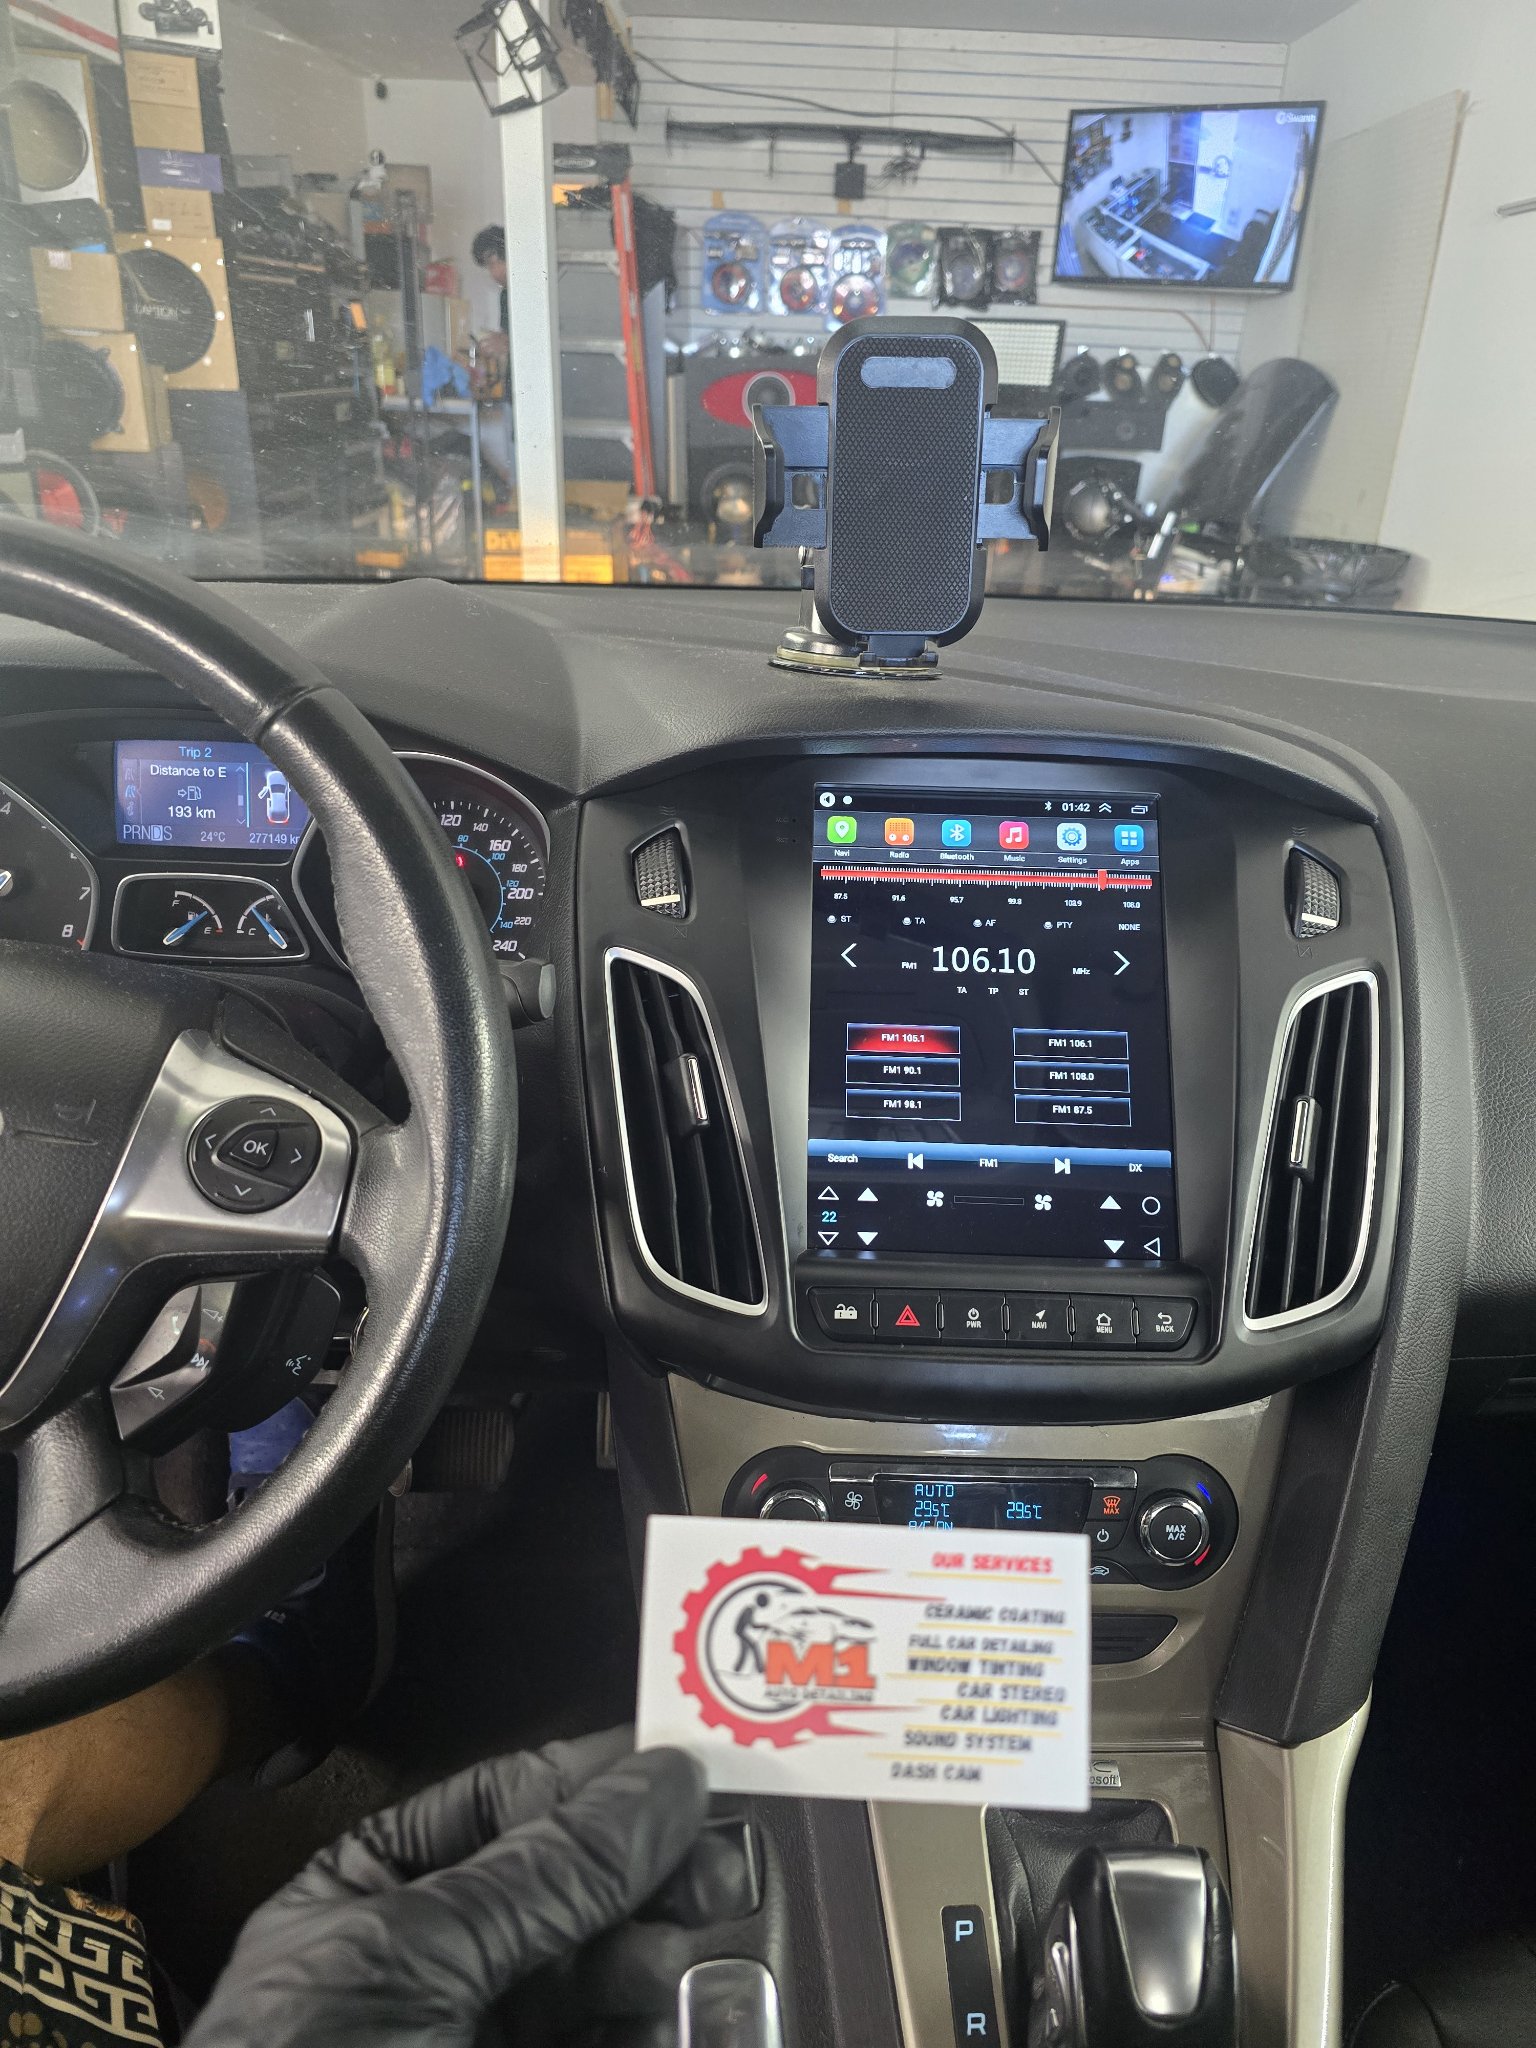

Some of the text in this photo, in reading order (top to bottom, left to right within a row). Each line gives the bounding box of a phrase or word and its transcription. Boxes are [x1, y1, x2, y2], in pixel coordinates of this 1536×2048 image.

[179, 747, 212, 758] Trip 2
[150, 765, 227, 778] Distance to E
[0, 802, 11, 815] 4
[1062, 801, 1091, 813] 01:42
[168, 806, 216, 819] 193 km
[440, 814, 462, 826] 120
[473, 823, 489, 832] 140
[200, 831, 226, 843] 24°C
[249, 833, 288, 844] 277149
[489, 840, 511, 851] 160
[492, 853, 505, 861] 100
[833, 849, 850, 858] Navi
[889, 850, 910, 859] Radio
[940, 852, 975, 862] Bluetooth
[1003, 854, 1026, 863] Music
[1057, 856, 1088, 866] Settings
[1120, 857, 1140, 867] Apps
[512, 864, 528, 873] 180
[506, 880, 519, 888] 120
[79, 886, 91, 900] 7
[507, 888, 534, 900] 200
[833, 892, 848, 901] 87.5
[950, 895, 965, 904] 95.7
[514, 917, 532, 926] 220
[840, 915, 852, 924] ST
[914, 917, 926, 926] TA
[985, 919, 997, 927] AF
[500, 921, 513, 929] 140
[1056, 920, 1074, 930] PTY
[1118, 922, 1141, 932] NONE
[62, 924, 74, 938] 8
[204, 927, 212, 935] E
[248, 928, 257, 936] C
[492, 939, 518, 952] 240
[901, 945, 1091, 976] FM1 106.10 MHz
[956, 986, 1030, 996] TA TP ST
[881, 1033, 925, 1043] FM1 105.1
[1048, 1038, 1092, 1048] FM1 106.1
[883, 1065, 922, 1075] FM1 90.1
[1049, 1071, 1095, 1081] FM1 108.0
[883, 1099, 922, 1109] FM1 98.1
[1052, 1105, 1093, 1115] FM1 87.5
[243, 1140, 270, 1156] OK
[827, 1153, 858, 1163] Search
[979, 1158, 998, 1168] FM1
[1128, 1163, 1143, 1172] DX
[821, 1211, 838, 1223] 22
[966, 1320, 982, 1329] PWR
[1031, 1321, 1048, 1330] NAVI
[1096, 1325, 1113, 1334] MENU
[1155, 1324, 1175, 1333] BACK
[914, 1484, 955, 1498] AUTO
[1102, 1506, 1121, 1515] MAX
[1165, 1525, 1187, 1534] MAX
[1167, 1533, 1186, 1542] A/C
[932, 1552, 1053, 1573] OUR SERVICES
[925, 1604, 1066, 1625] CERAMIC COATING
[908, 1634, 1054, 1655] FULL CAR DETAILING
[766, 1640, 877, 1689] M1
[907, 1657, 1044, 1677] WINDOW TINTING
[958, 1682, 1067, 1702] CAR STEREO
[940, 1705, 1058, 1726] CAR LIGHTING
[904, 1731, 1033, 1751] SOUND SYSTEM
[890, 1762, 983, 1781] DASH CAM
[955, 1920, 974, 1942] P
[967, 2012, 987, 2036] R
